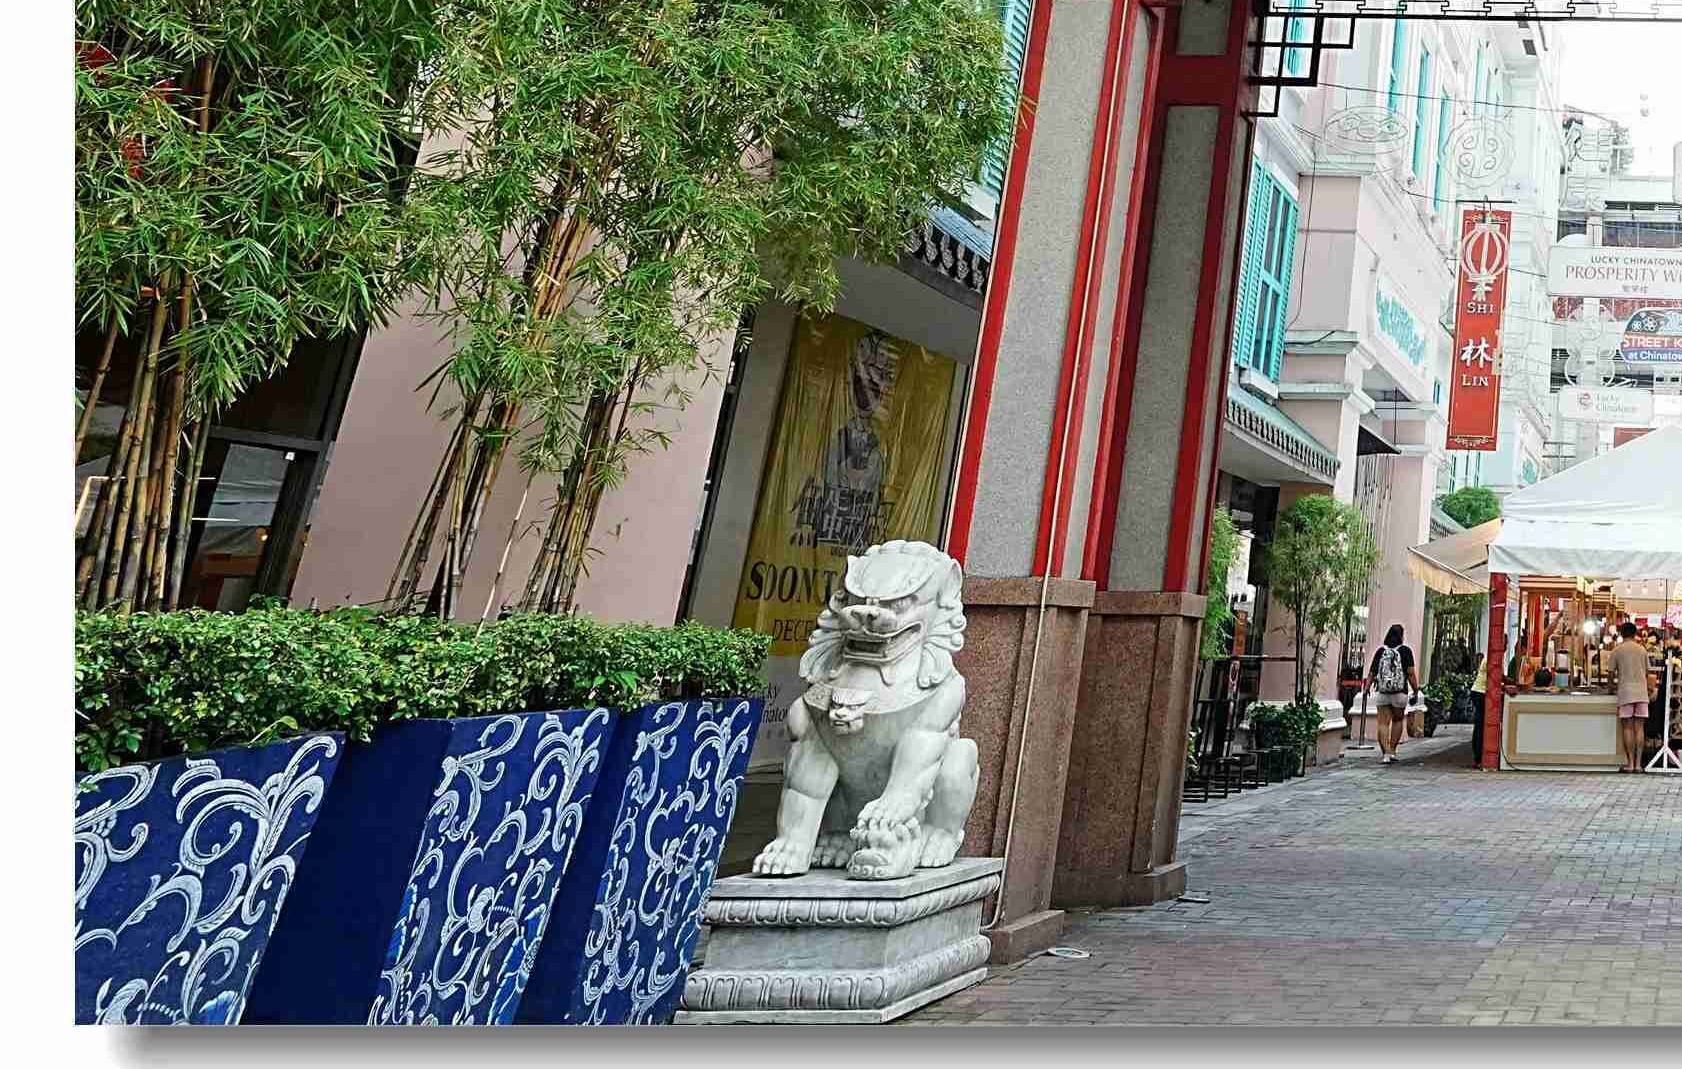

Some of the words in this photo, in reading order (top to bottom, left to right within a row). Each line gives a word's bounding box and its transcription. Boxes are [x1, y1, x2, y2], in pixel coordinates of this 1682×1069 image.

[1591, 255, 1619, 265] LUCKY
[1565, 265, 1657, 283] PROSPERITY
[1466, 302, 1494, 315] SHI
[1622, 333, 1668, 349] STREET
[1460, 336, 1495, 369] 林
[1627, 351, 1638, 361] at
[1461, 373, 1488, 387] LIN
